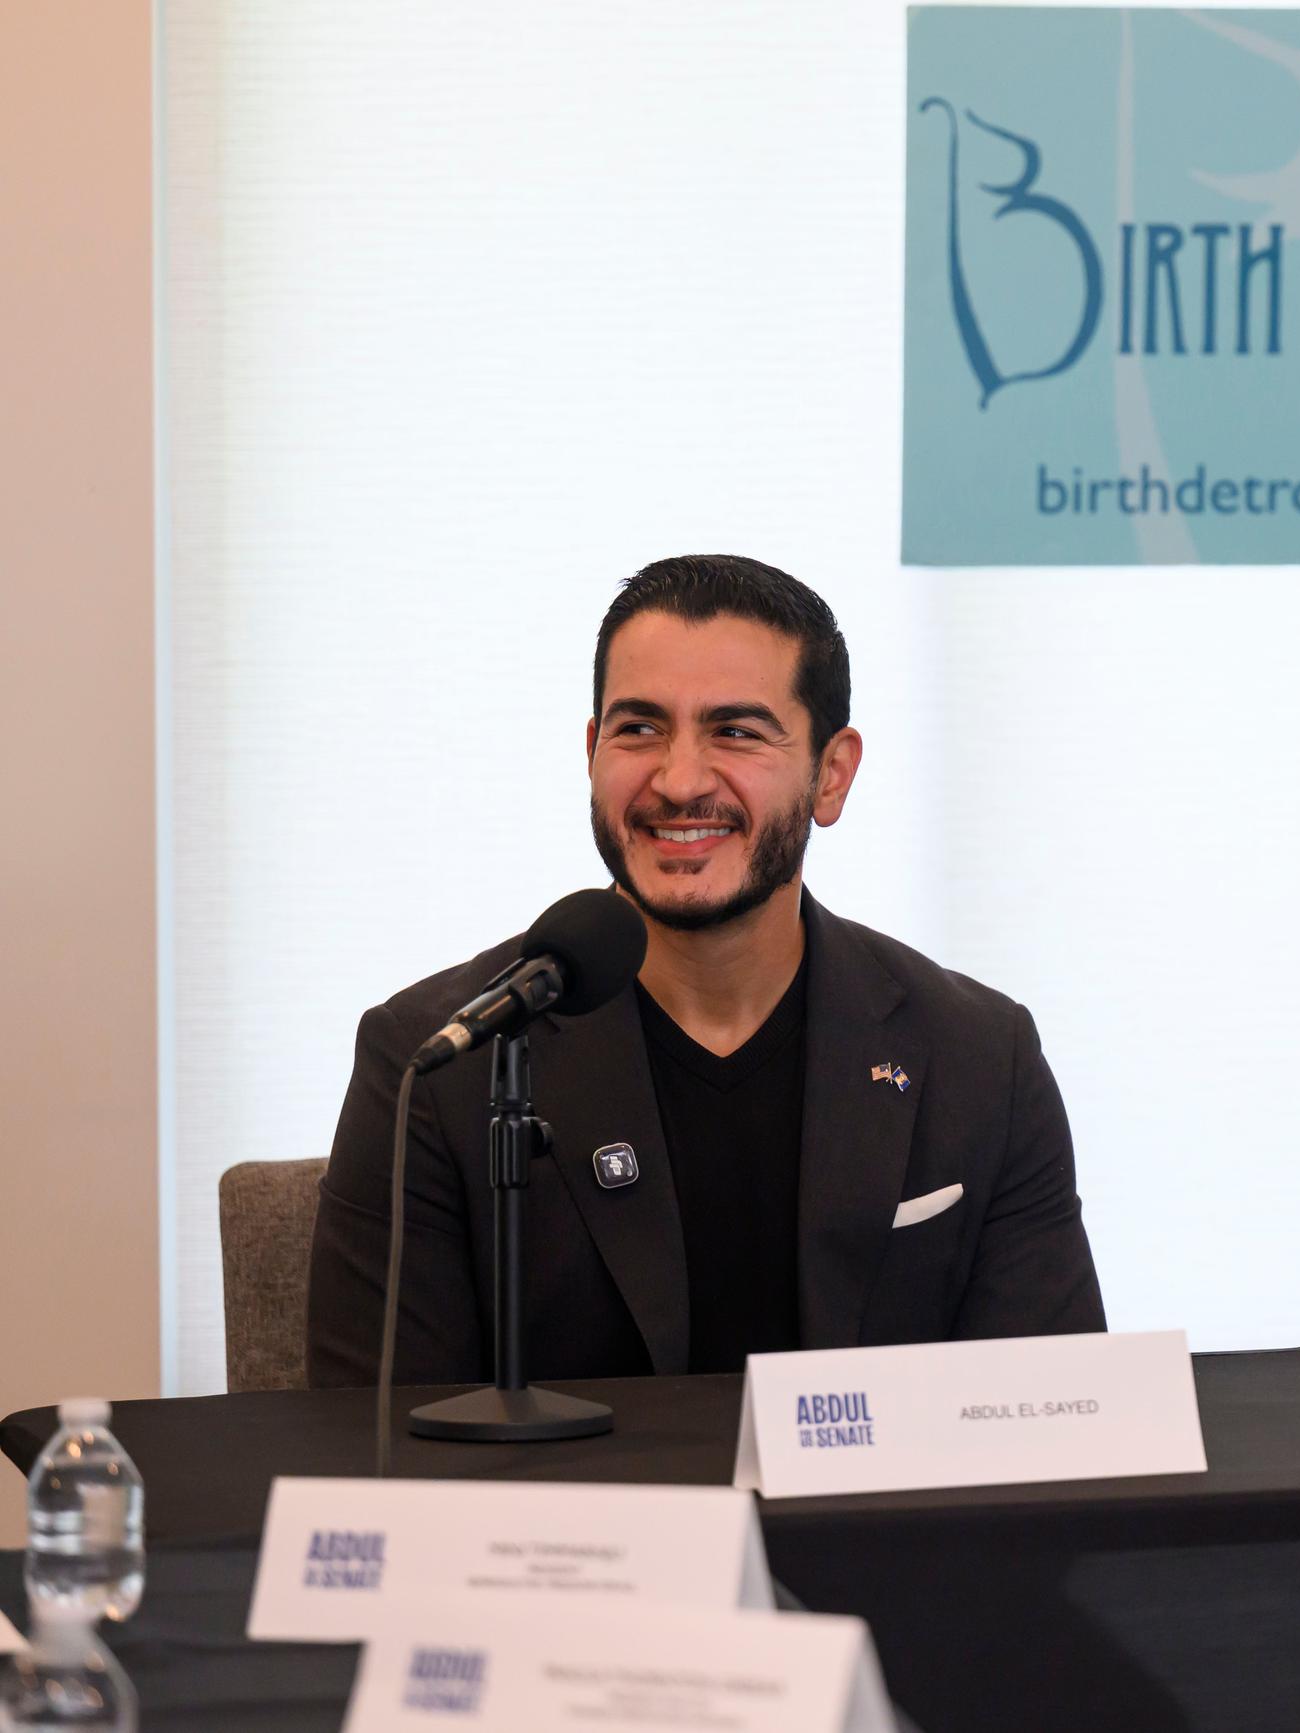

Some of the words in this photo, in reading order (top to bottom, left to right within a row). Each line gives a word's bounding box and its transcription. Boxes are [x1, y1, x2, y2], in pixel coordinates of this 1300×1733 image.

[919, 97, 1285, 412] BIRTH
[797, 1392, 873, 1425] ABDUL
[960, 1404, 1015, 1420] ABDUL
[1018, 1399, 1100, 1418] EL-SAYED
[816, 1425, 875, 1448] SENATE
